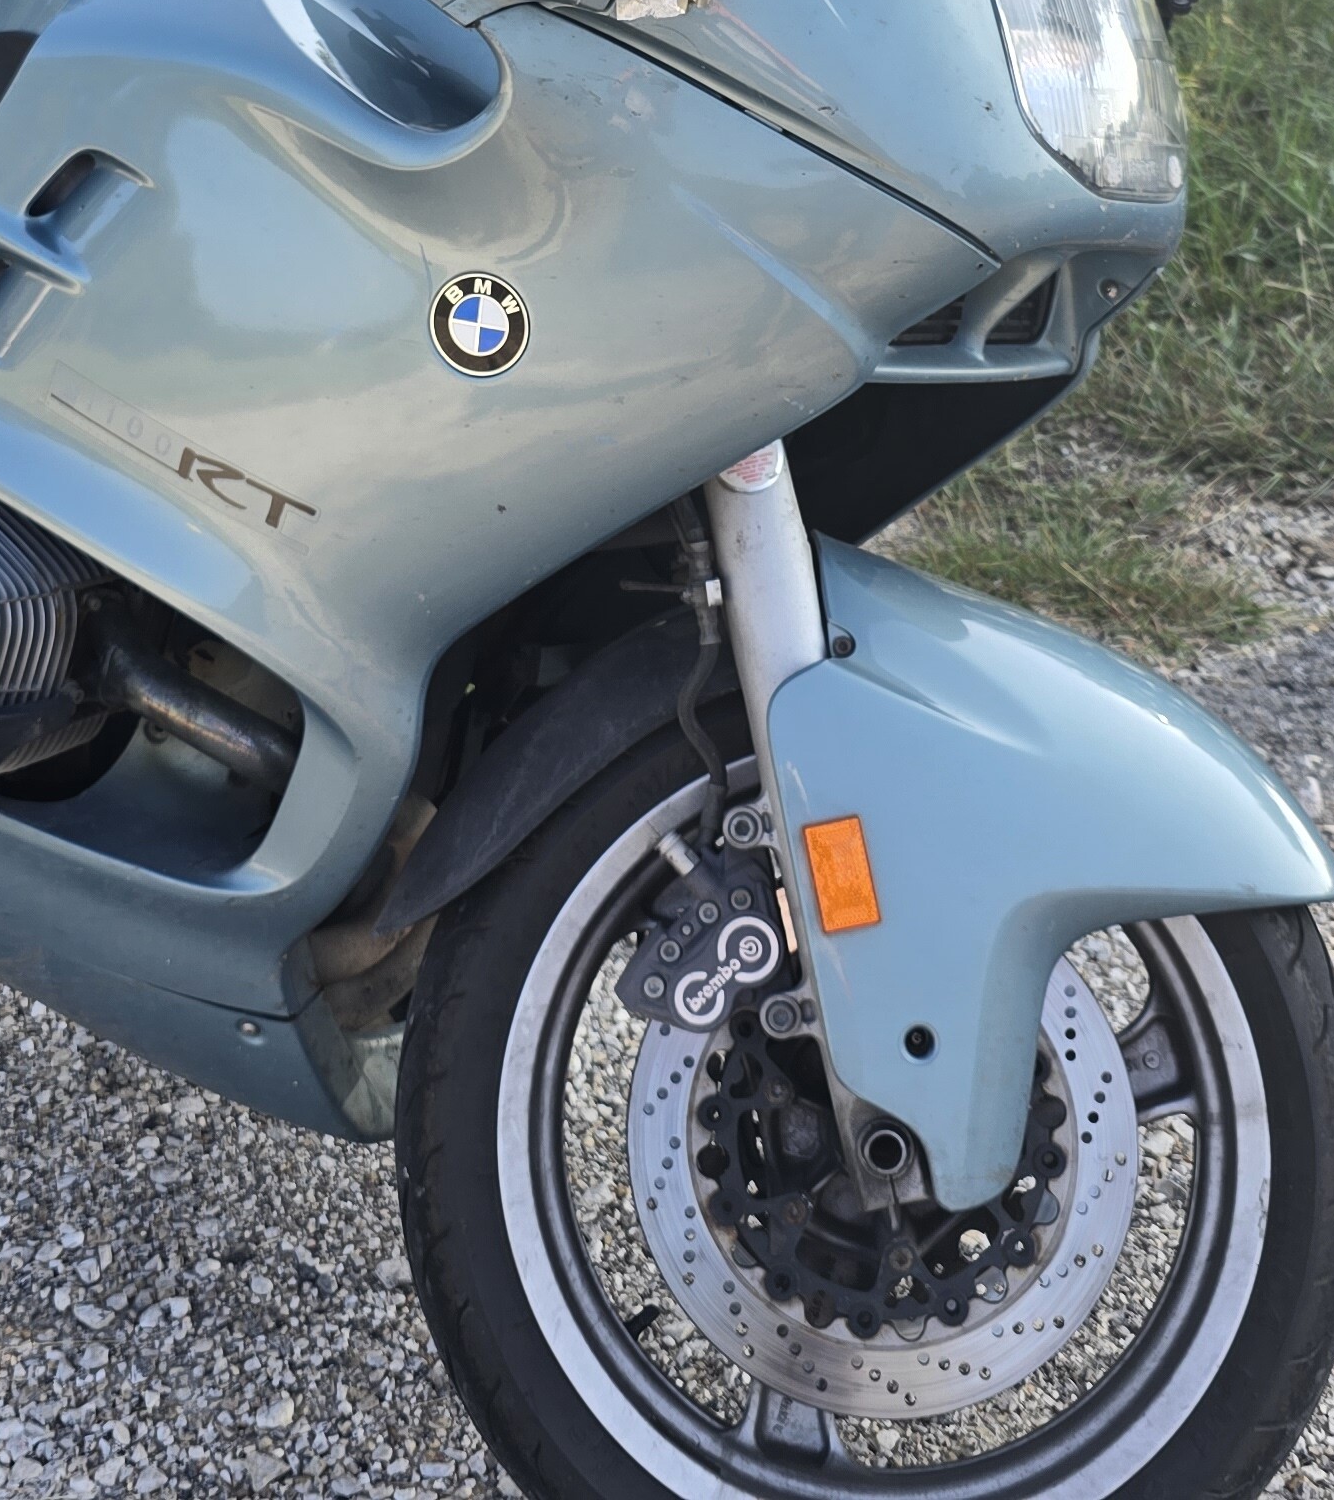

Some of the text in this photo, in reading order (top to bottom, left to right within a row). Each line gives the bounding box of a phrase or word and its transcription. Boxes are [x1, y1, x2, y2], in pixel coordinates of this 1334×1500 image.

[444, 277, 520, 315] BMW
[177, 445, 318, 529] RT
[685, 956, 742, 1013] brembo
